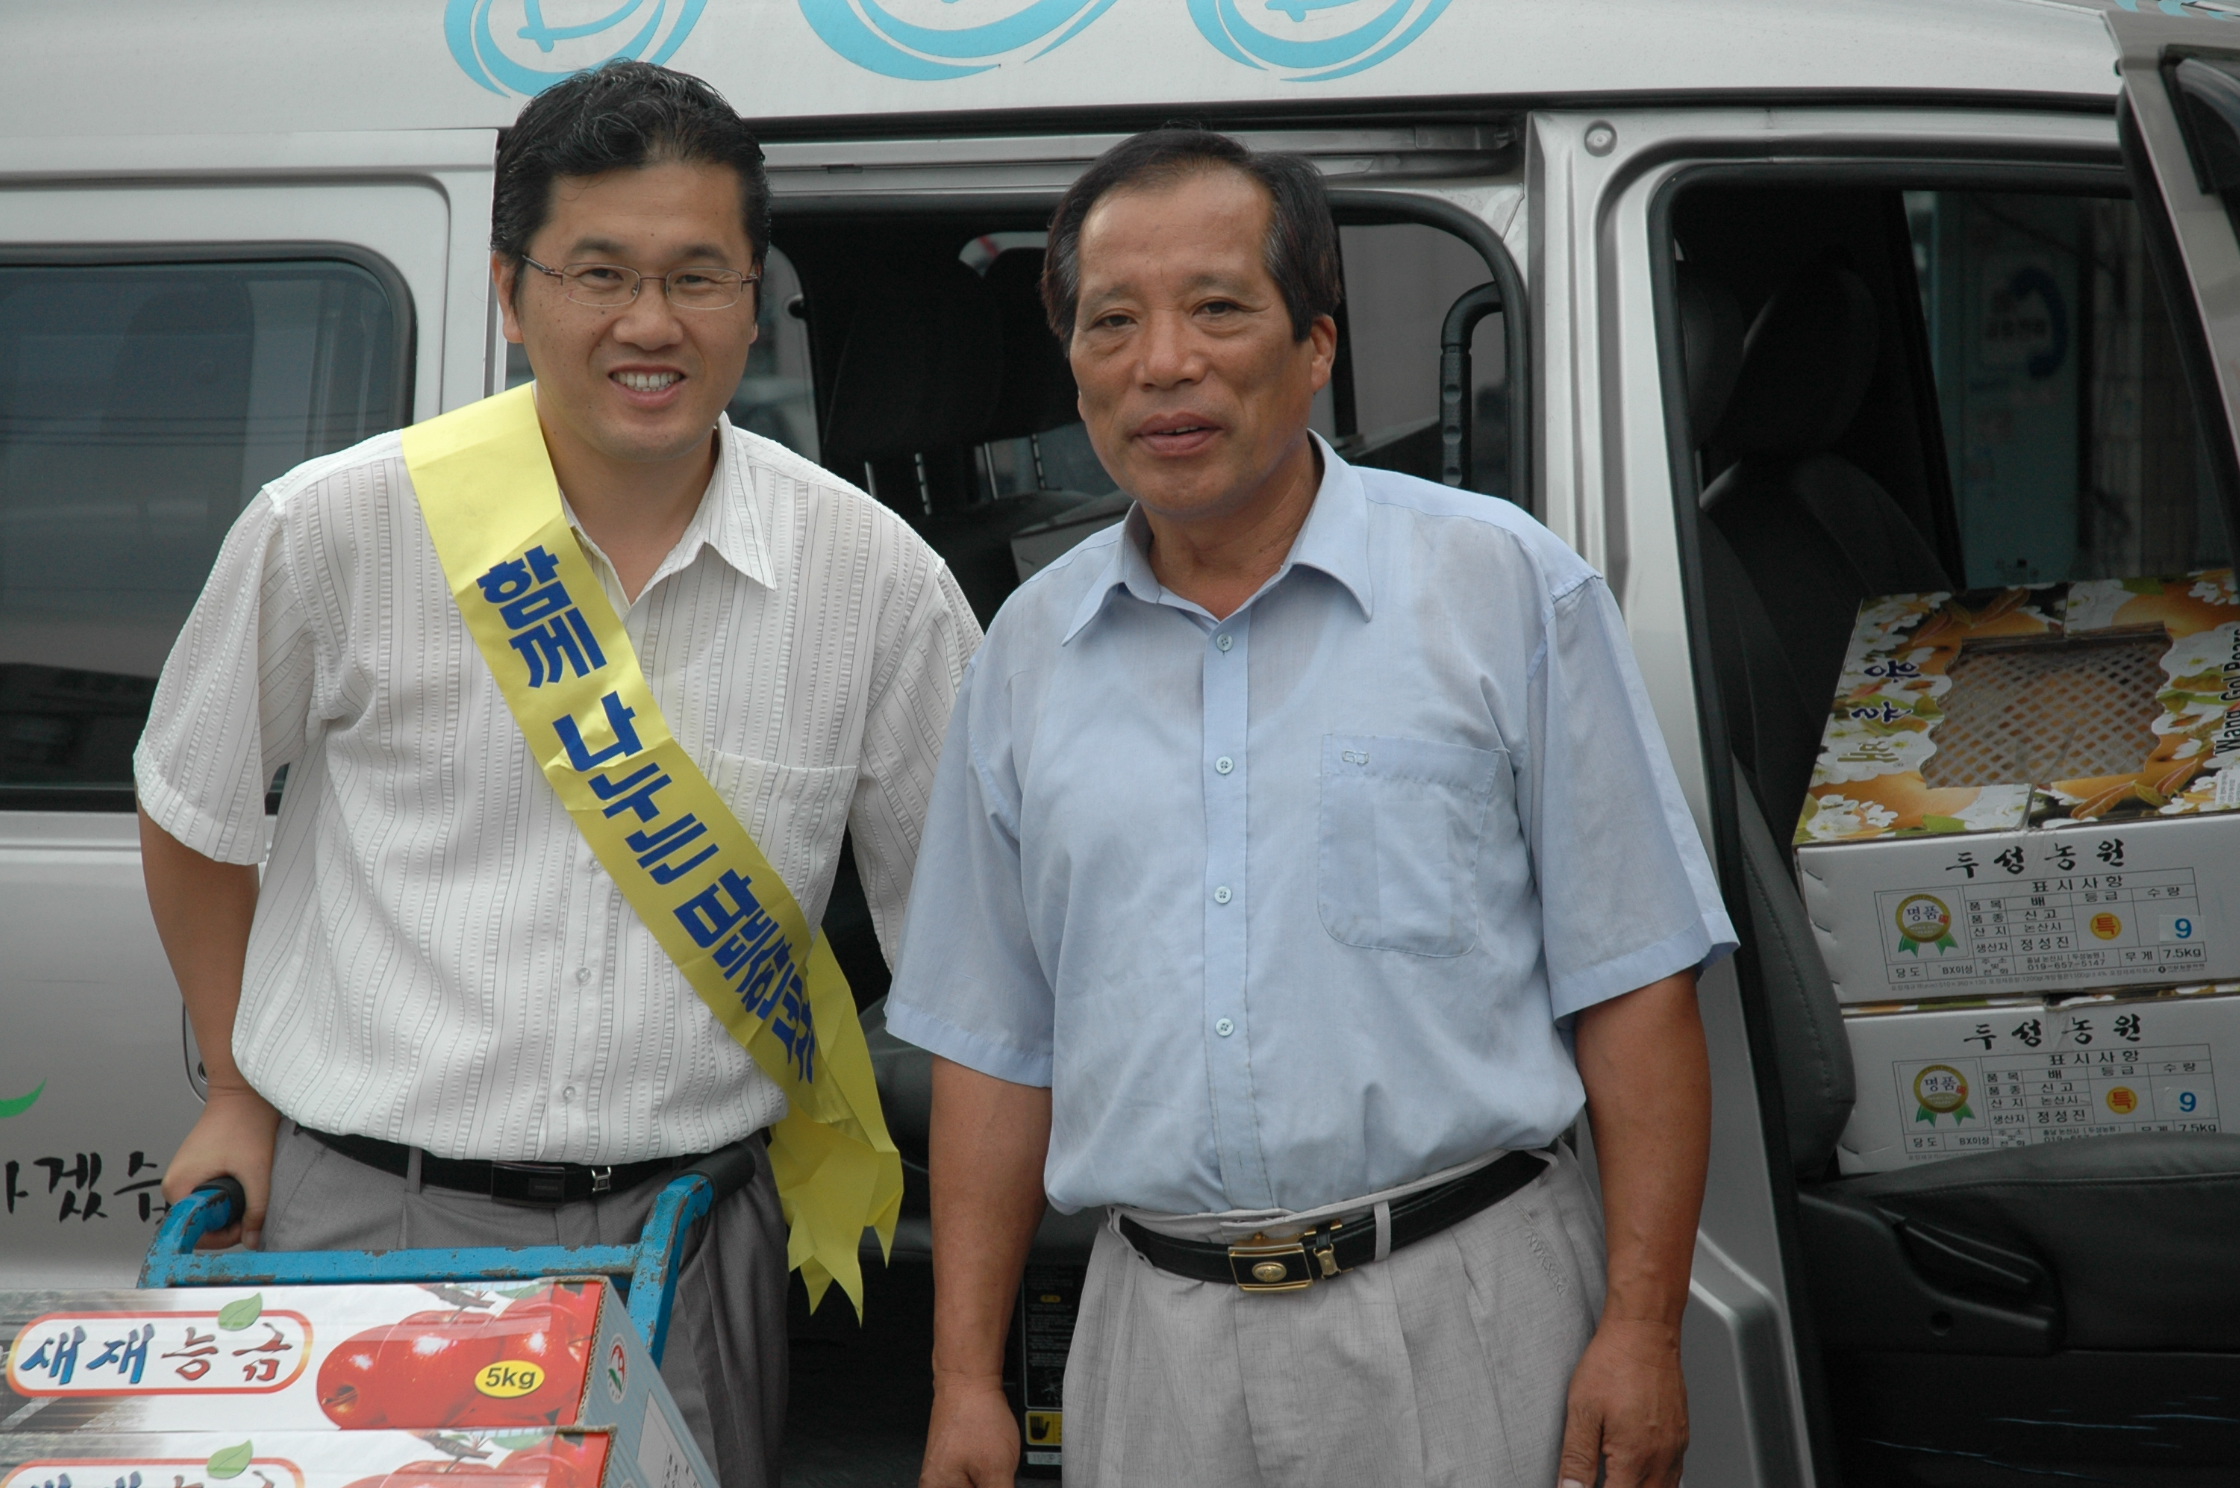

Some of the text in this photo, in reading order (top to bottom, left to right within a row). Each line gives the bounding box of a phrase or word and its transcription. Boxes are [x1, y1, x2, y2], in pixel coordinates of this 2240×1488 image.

[476, 545, 607, 689] 함께
[552, 691, 719, 886] 나누는
[2031, 875, 2124, 893] 표시사항
[1906, 905, 1939, 921] 명품
[2095, 917, 2116, 935] 특
[2174, 918, 2192, 939] 9
[2020, 936, 2069, 952] 정성진
[2163, 948, 2202, 960] 7.5kg
[2049, 1050, 2139, 1066] 표시사항
[1924, 1075, 1956, 1091] 명품
[2112, 1091, 2132, 1109] 특
[2179, 1091, 2197, 1113] 9
[2037, 1109, 2086, 1124] 정성진
[485, 1365, 537, 1391] 5kg
